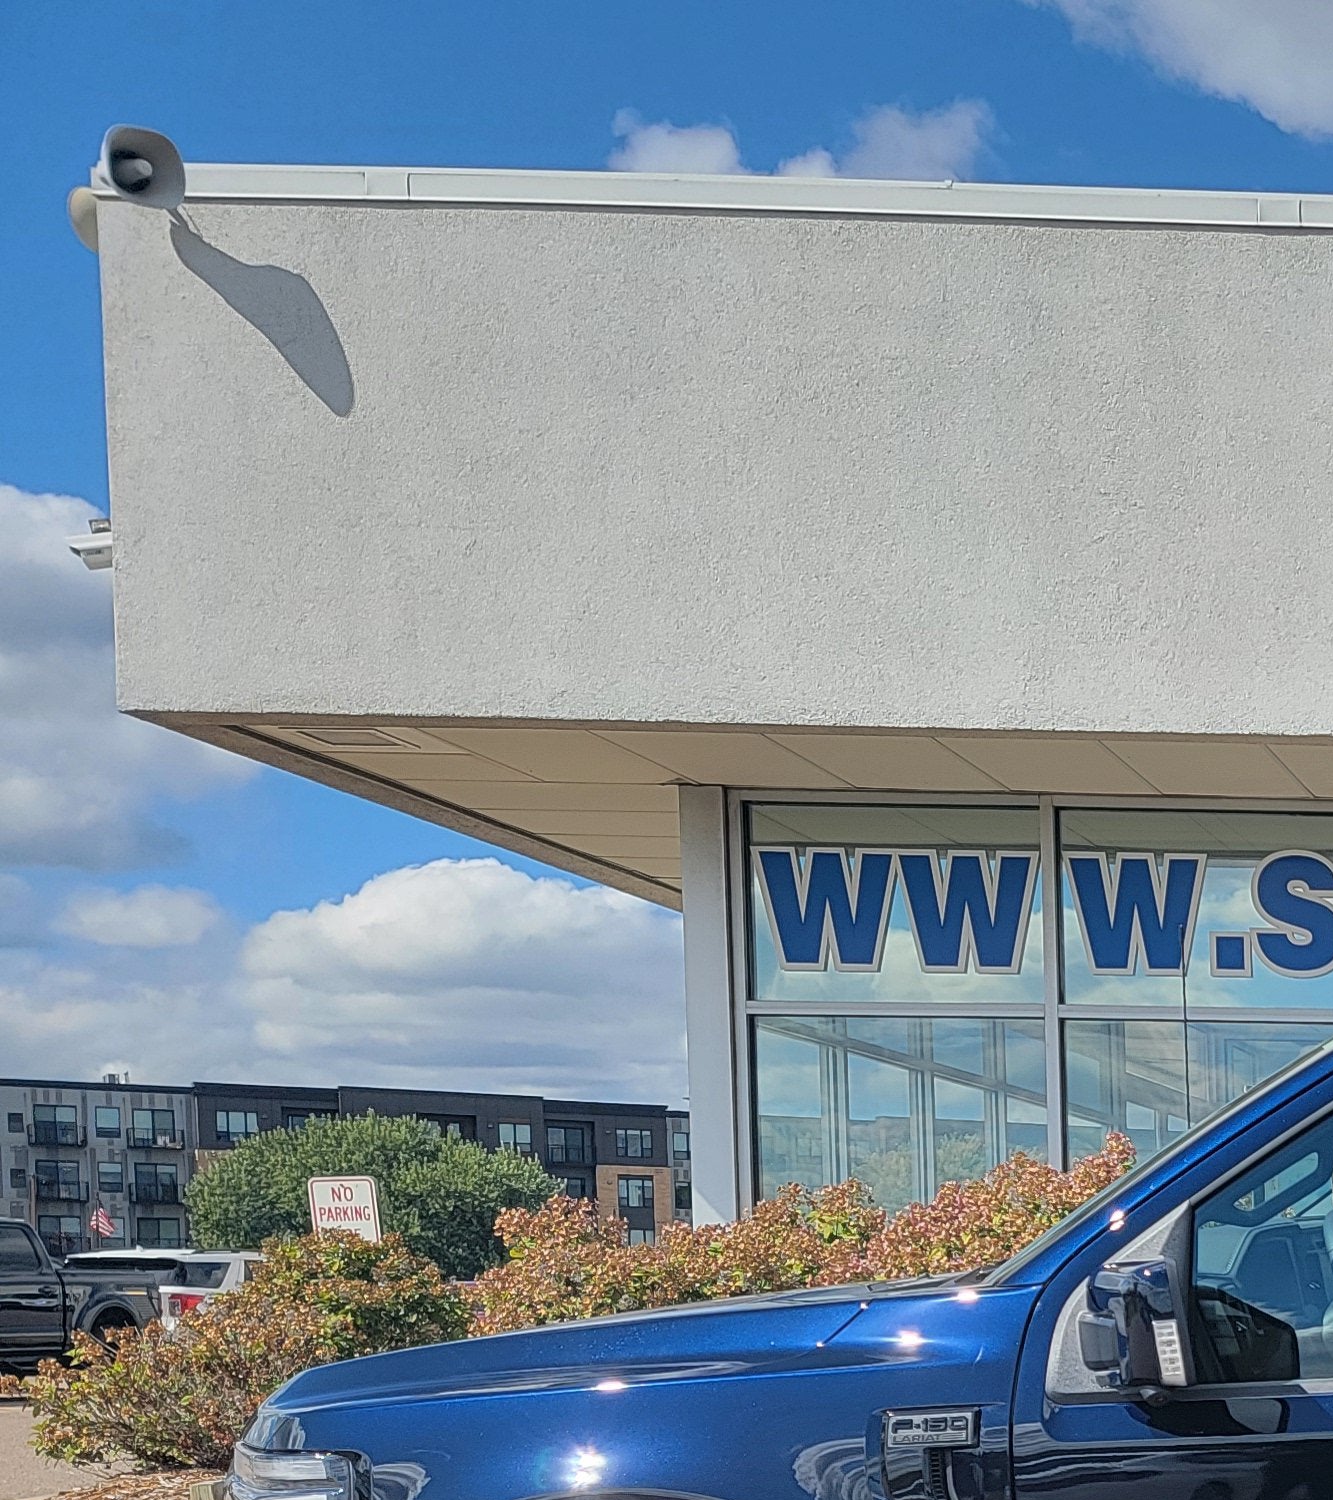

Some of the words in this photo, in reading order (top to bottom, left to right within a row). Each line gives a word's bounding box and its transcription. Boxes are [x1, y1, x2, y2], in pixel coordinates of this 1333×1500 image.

[331, 1186, 354, 1203] NO
[319, 1205, 371, 1222] PARKING
[891, 1416, 968, 1434] F-150
[892, 1434, 941, 1443] LARIAT
